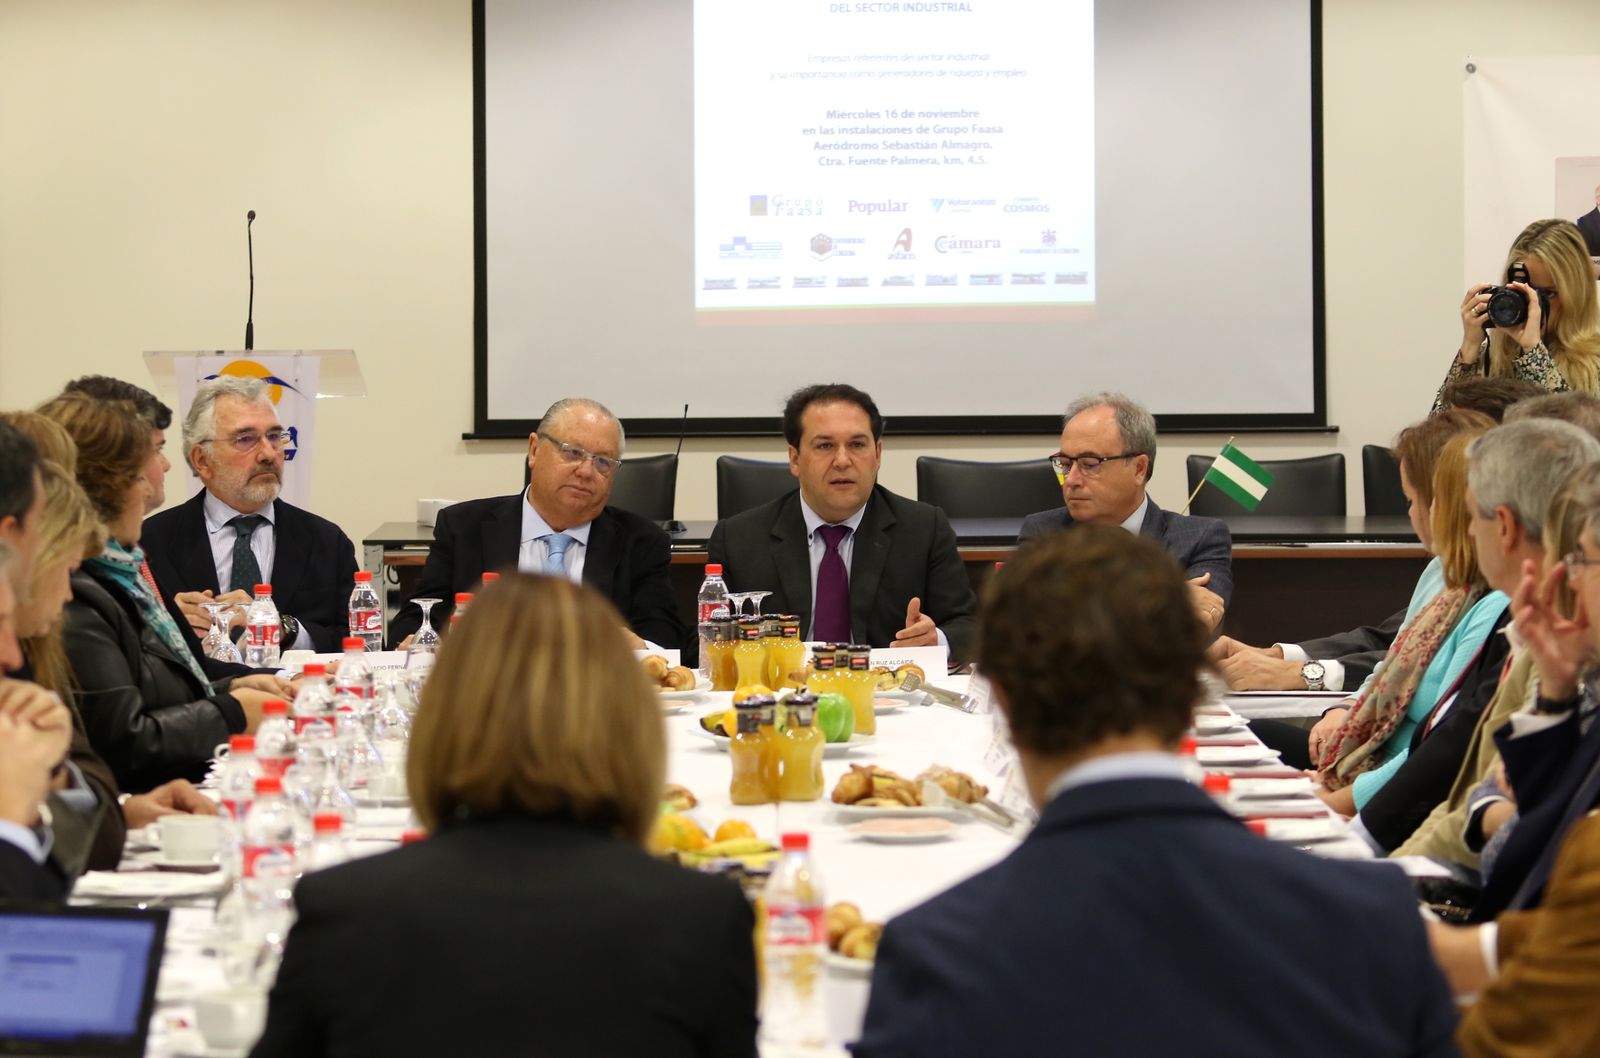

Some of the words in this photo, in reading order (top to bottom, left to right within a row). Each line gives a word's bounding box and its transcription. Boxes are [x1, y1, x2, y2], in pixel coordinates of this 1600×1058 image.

[830, 3, 851, 13] DEL
[855, 2, 900, 12] SECTOR
[903, 2, 973, 12] INDUSTRIAL
[826, 109, 881, 120] Miércoles
[884, 110, 898, 119] 16
[901, 109, 916, 119] de
[918, 108, 980, 118] noviembre
[802, 127, 816, 135] en
[819, 126, 835, 135] las
[838, 125, 913, 135] instalaciones
[916, 125, 931, 134] de
[933, 124, 969, 136] Grupo
[972, 124, 1004, 134] Faasa
[813, 140, 879, 151] Aeródromo
[882, 140, 938, 150] Sebastián
[941, 139, 993, 152] Almagro.
[818, 157, 845, 166] Ctra.
[848, 156, 888, 166] Fuente
[848, 199, 908, 216] Popular
